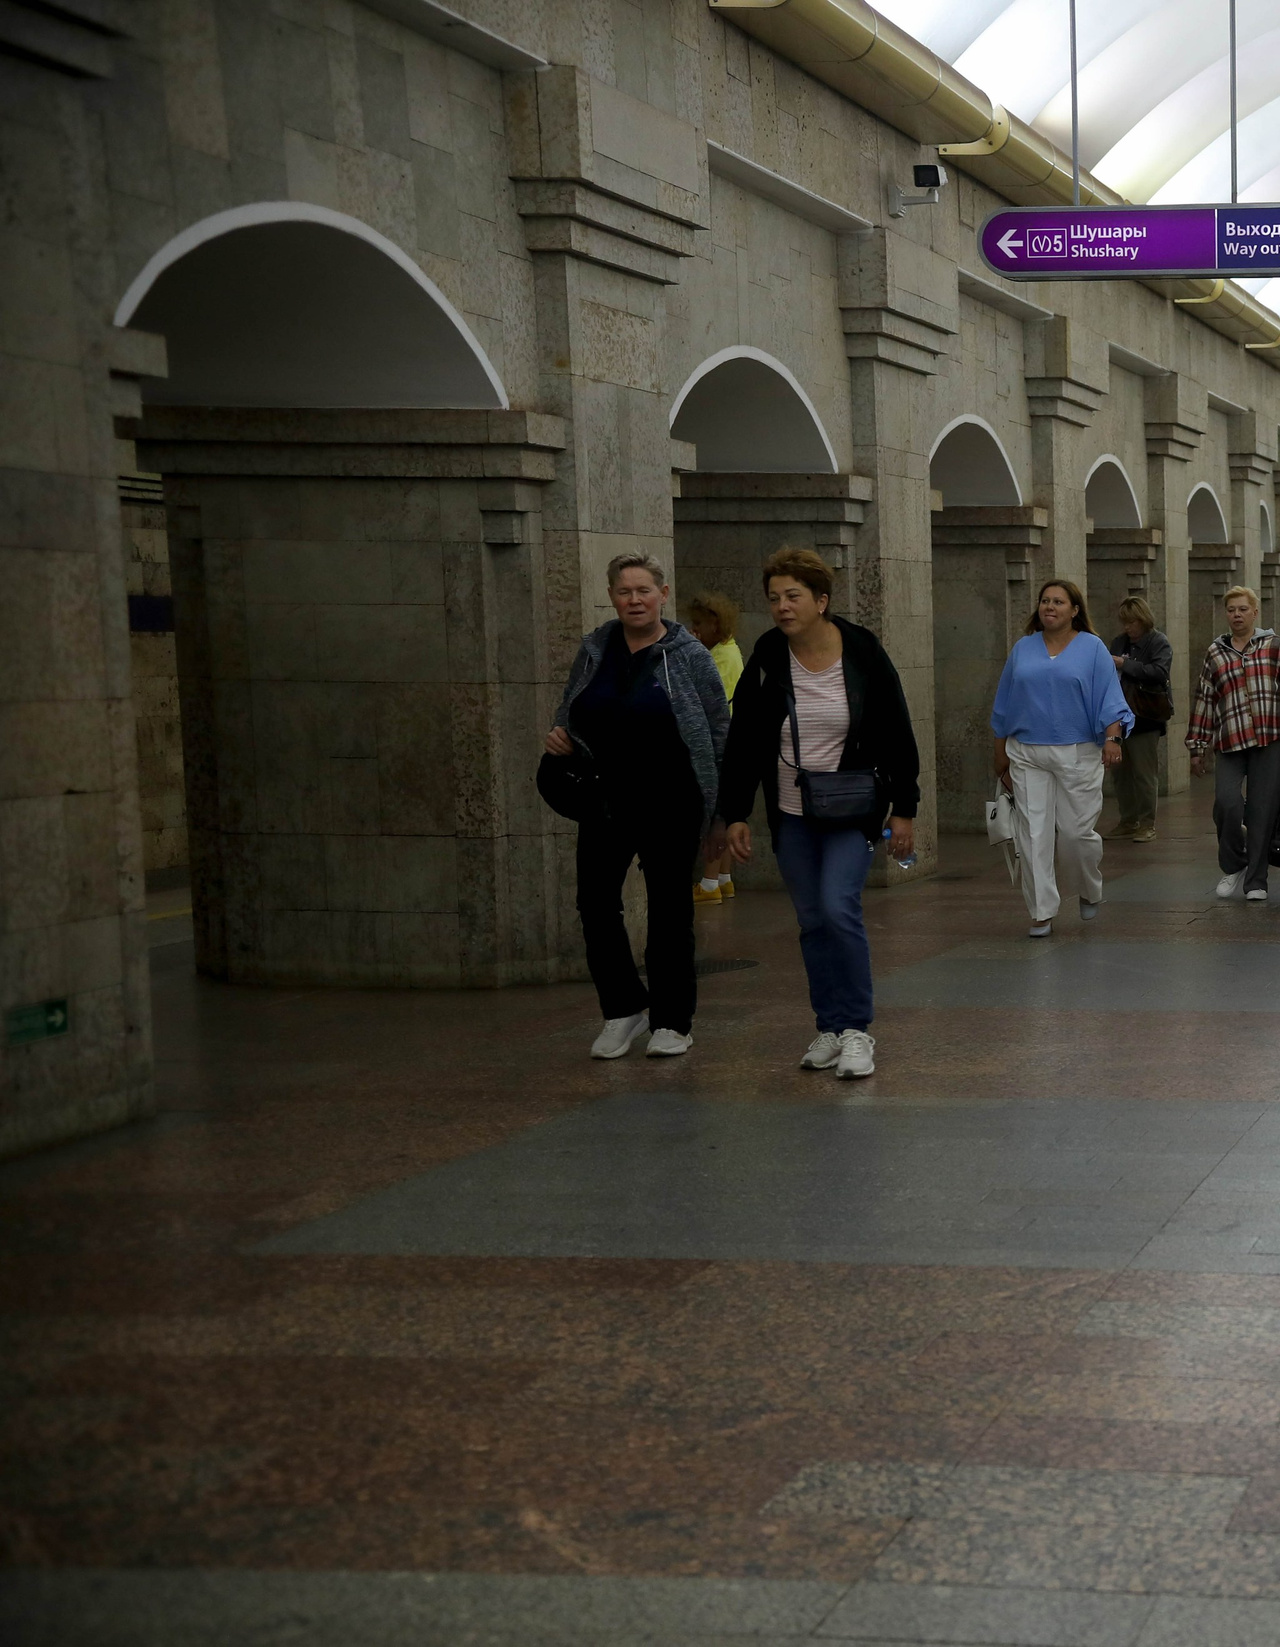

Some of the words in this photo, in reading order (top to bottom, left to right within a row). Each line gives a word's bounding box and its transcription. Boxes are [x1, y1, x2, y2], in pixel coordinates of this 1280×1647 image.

[1070, 224, 1147, 242] Шушары
[1071, 243, 1139, 260] Shushary
[1223, 242, 1258, 258] Way
